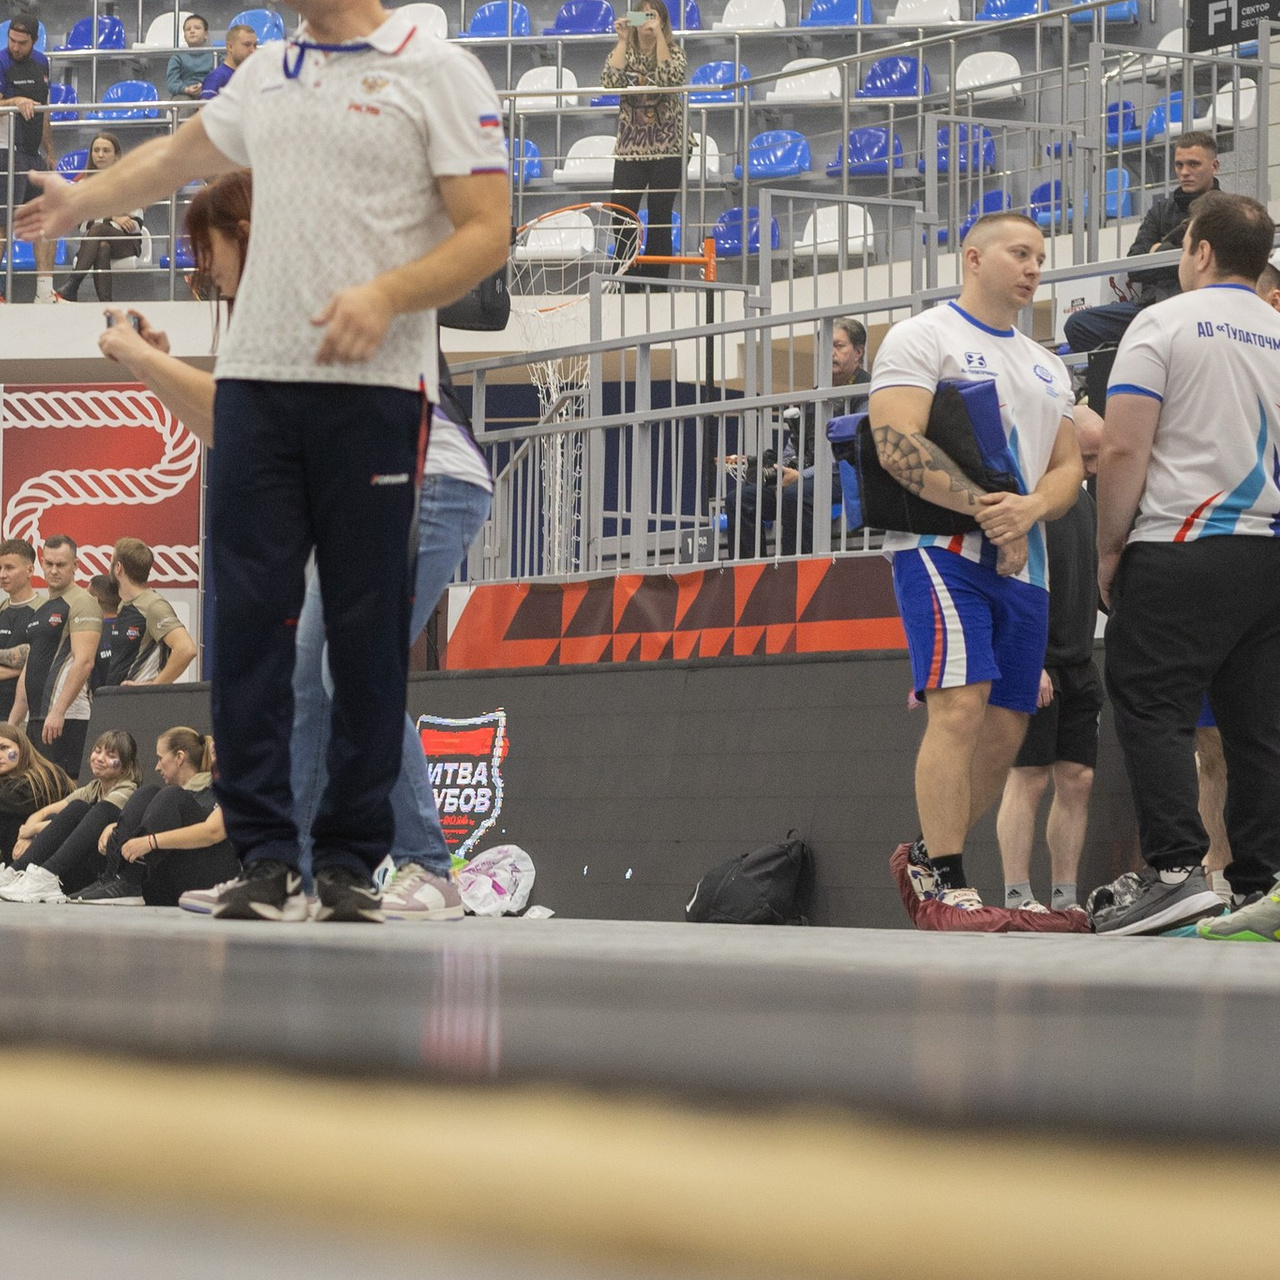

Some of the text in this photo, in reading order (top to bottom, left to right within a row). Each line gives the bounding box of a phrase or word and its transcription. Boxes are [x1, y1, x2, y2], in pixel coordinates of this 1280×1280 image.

[1241, 2, 1270, 16] СЕКТОР
[1197, 321, 1214, 337] АО
[426, 761, 488, 785] ИТВА
[432, 787, 492, 813] УБОВ
